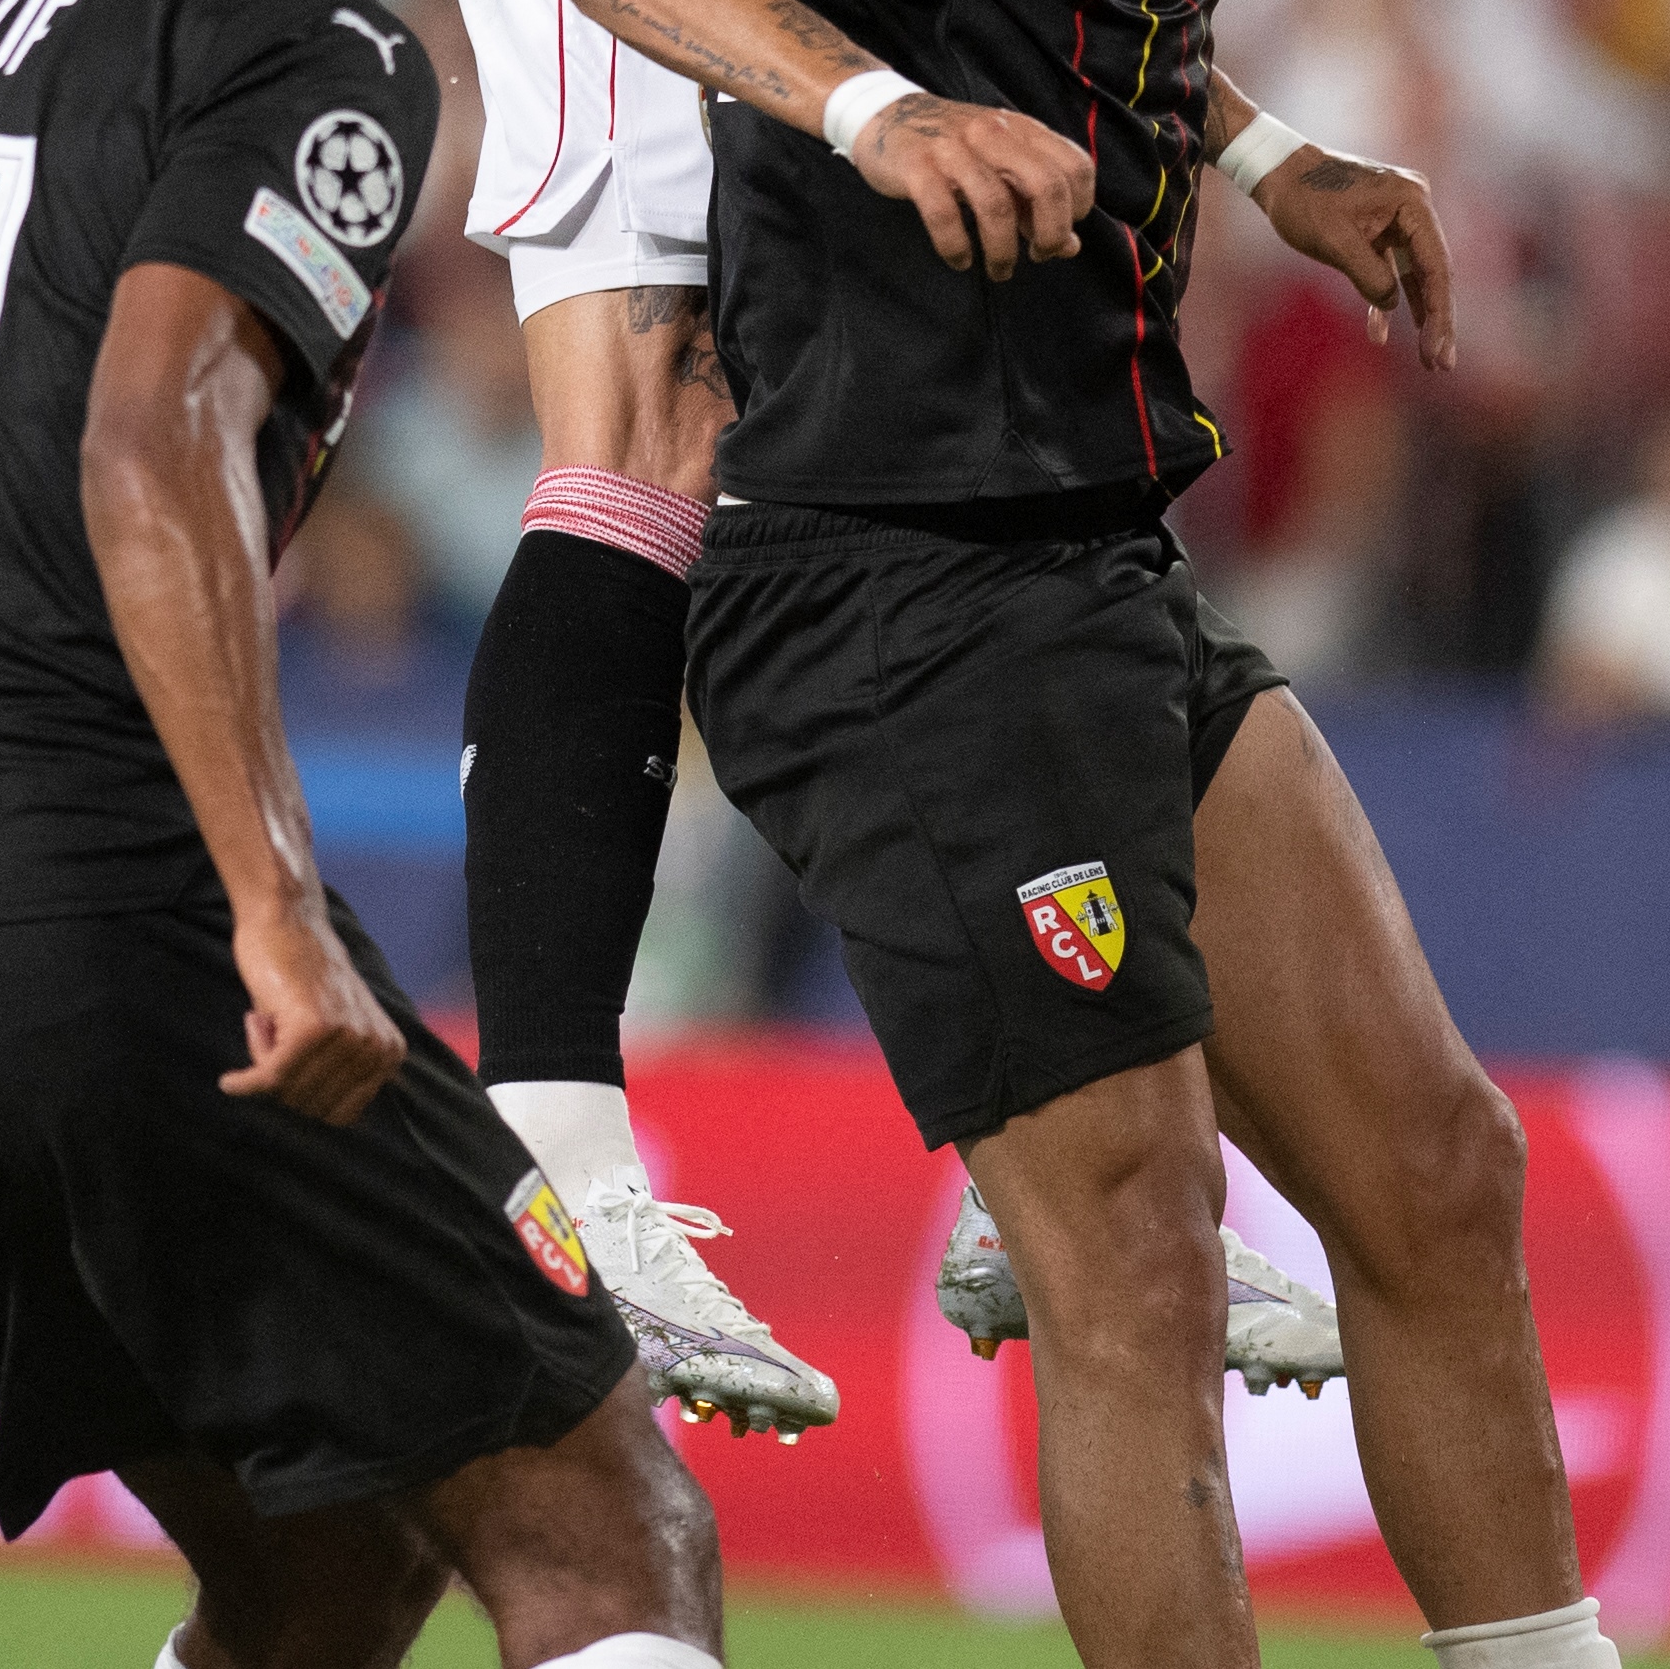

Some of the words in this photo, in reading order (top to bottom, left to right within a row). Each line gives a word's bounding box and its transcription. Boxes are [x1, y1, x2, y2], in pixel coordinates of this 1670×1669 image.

[1021, 883, 1051, 900] RACING
[1051, 876, 1074, 889] CLUB
[1074, 872, 1085, 882] DE
[1085, 866, 1105, 878] LENS
